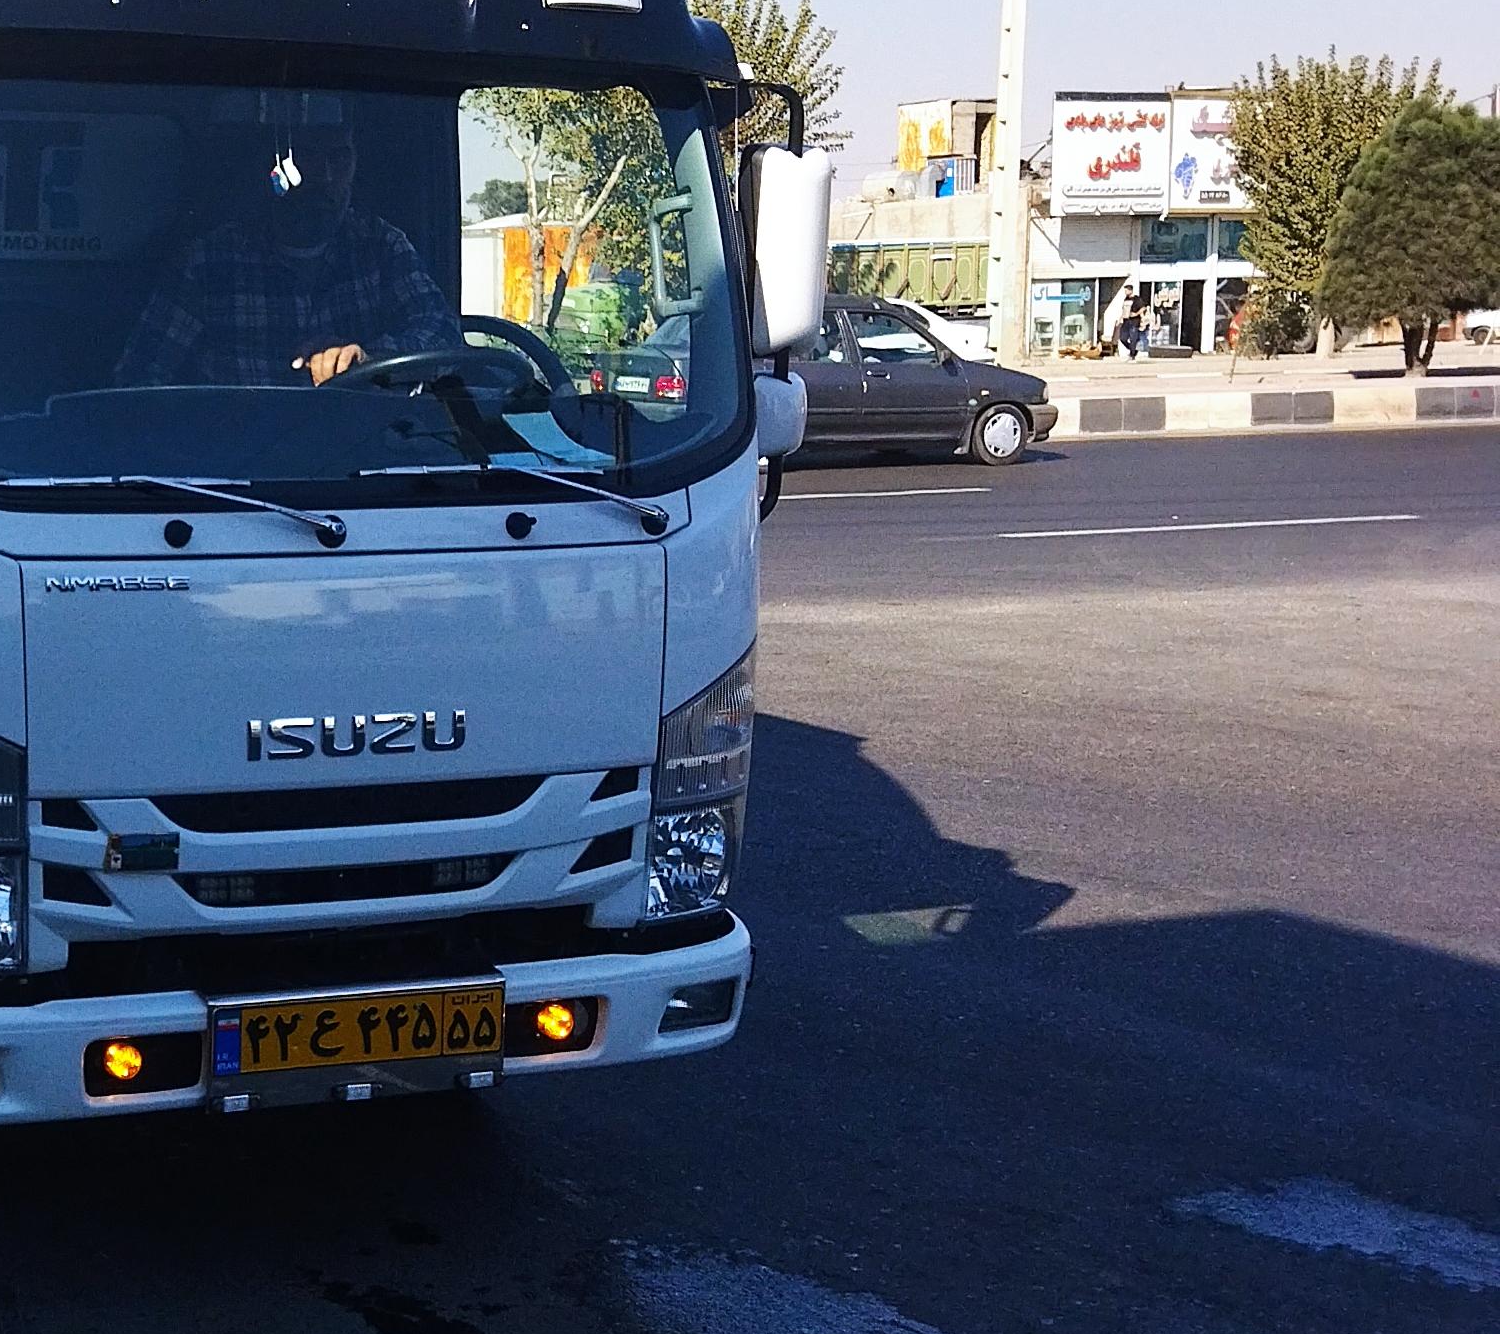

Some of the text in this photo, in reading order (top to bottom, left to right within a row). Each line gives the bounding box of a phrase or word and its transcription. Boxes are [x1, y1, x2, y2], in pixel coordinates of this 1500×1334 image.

[44, 234, 103, 251] KING
[247, 709, 466, 762] ISUZU
[451, 992, 494, 1006] ایران
